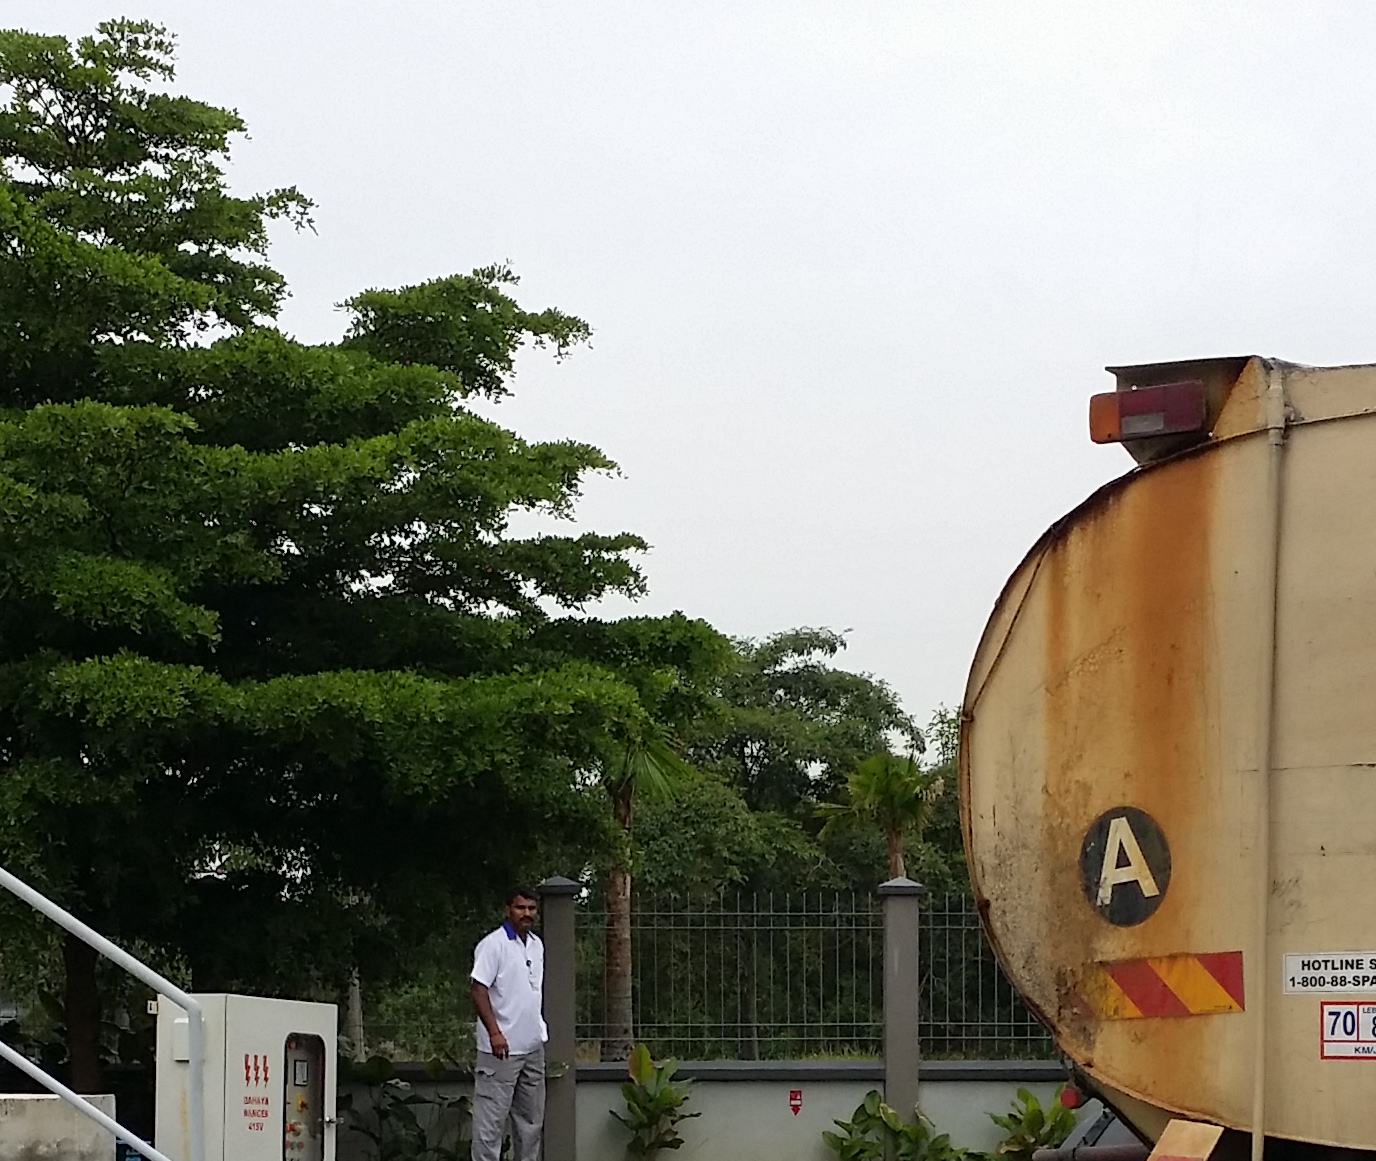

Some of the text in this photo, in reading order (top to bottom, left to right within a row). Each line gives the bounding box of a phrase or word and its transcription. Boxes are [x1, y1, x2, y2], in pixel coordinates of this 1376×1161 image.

[1096, 816, 1160, 906] A
[1301, 959, 1365, 971] HOTLINE
[1327, 1011, 1356, 1035] 70
